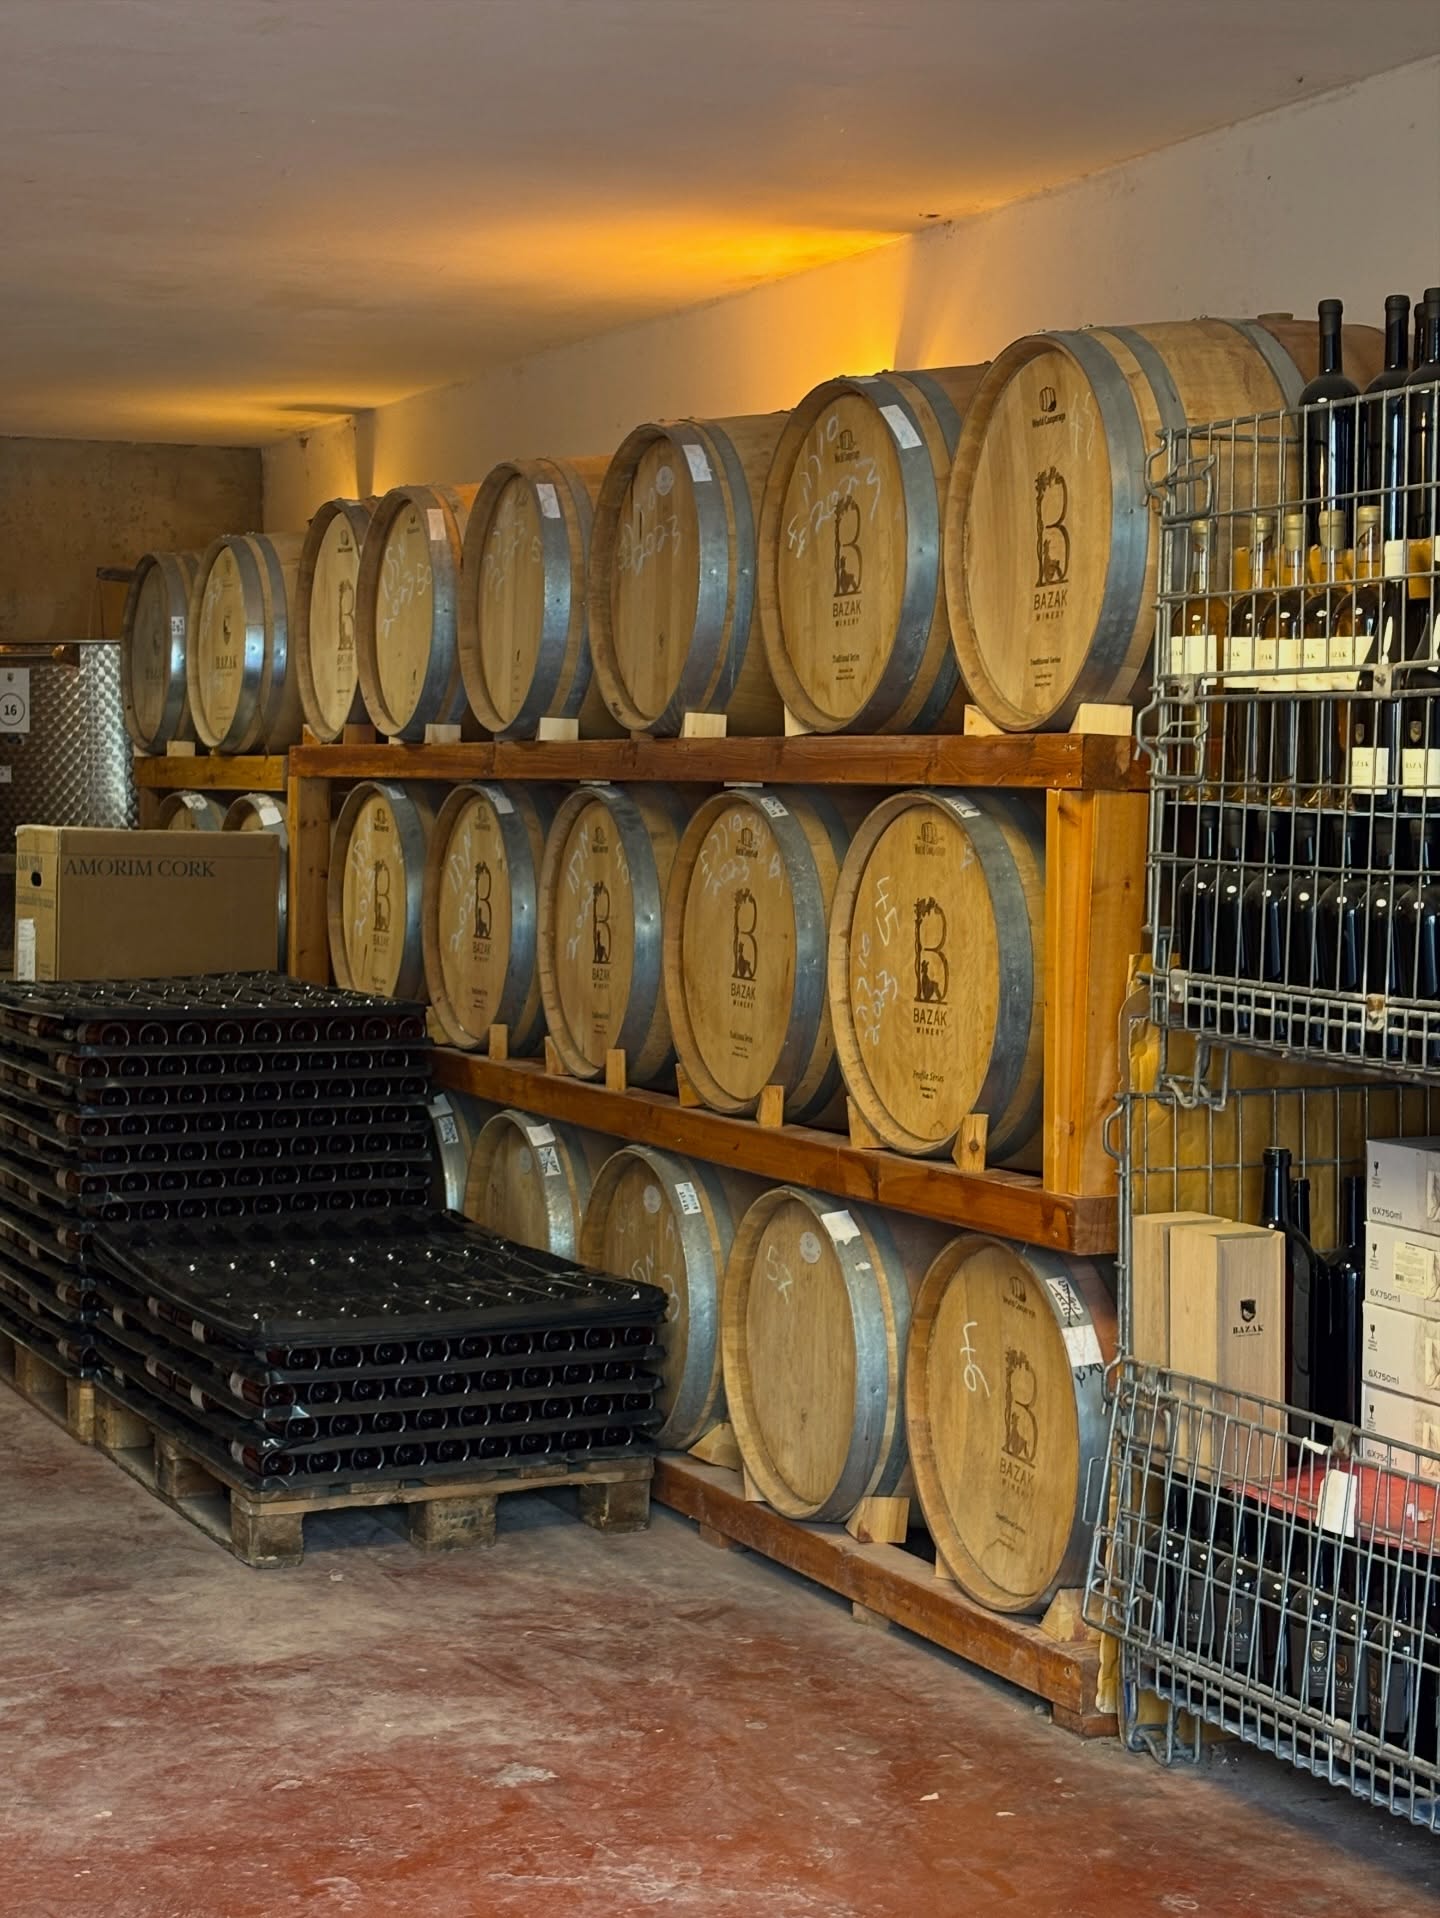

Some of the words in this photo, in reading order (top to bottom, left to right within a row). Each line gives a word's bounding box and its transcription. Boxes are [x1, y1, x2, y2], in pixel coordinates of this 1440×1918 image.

[832, 600, 862, 618] BAZAK
[1034, 590, 1068, 611] BAZAK
[1036, 611, 1064, 622] WINERY
[4, 704, 17, 716] 16
[63, 858, 153, 876] AMORIM
[158, 859, 216, 878] CORK
[730, 982, 756, 1000] BAZAK
[913, 1007, 948, 1027] BAZAK
[917, 1027, 944, 1036] WINERY
[1372, 1206, 1402, 1221] 6X750ml
[1370, 1288, 1401, 1303] 6X750ml
[1232, 1323, 1264, 1335] BAZAK
[960, 1321, 991, 1398] 46
[1368, 1369, 1400, 1385] 6X750ml
[1000, 1457, 1035, 1488] BAZAK
